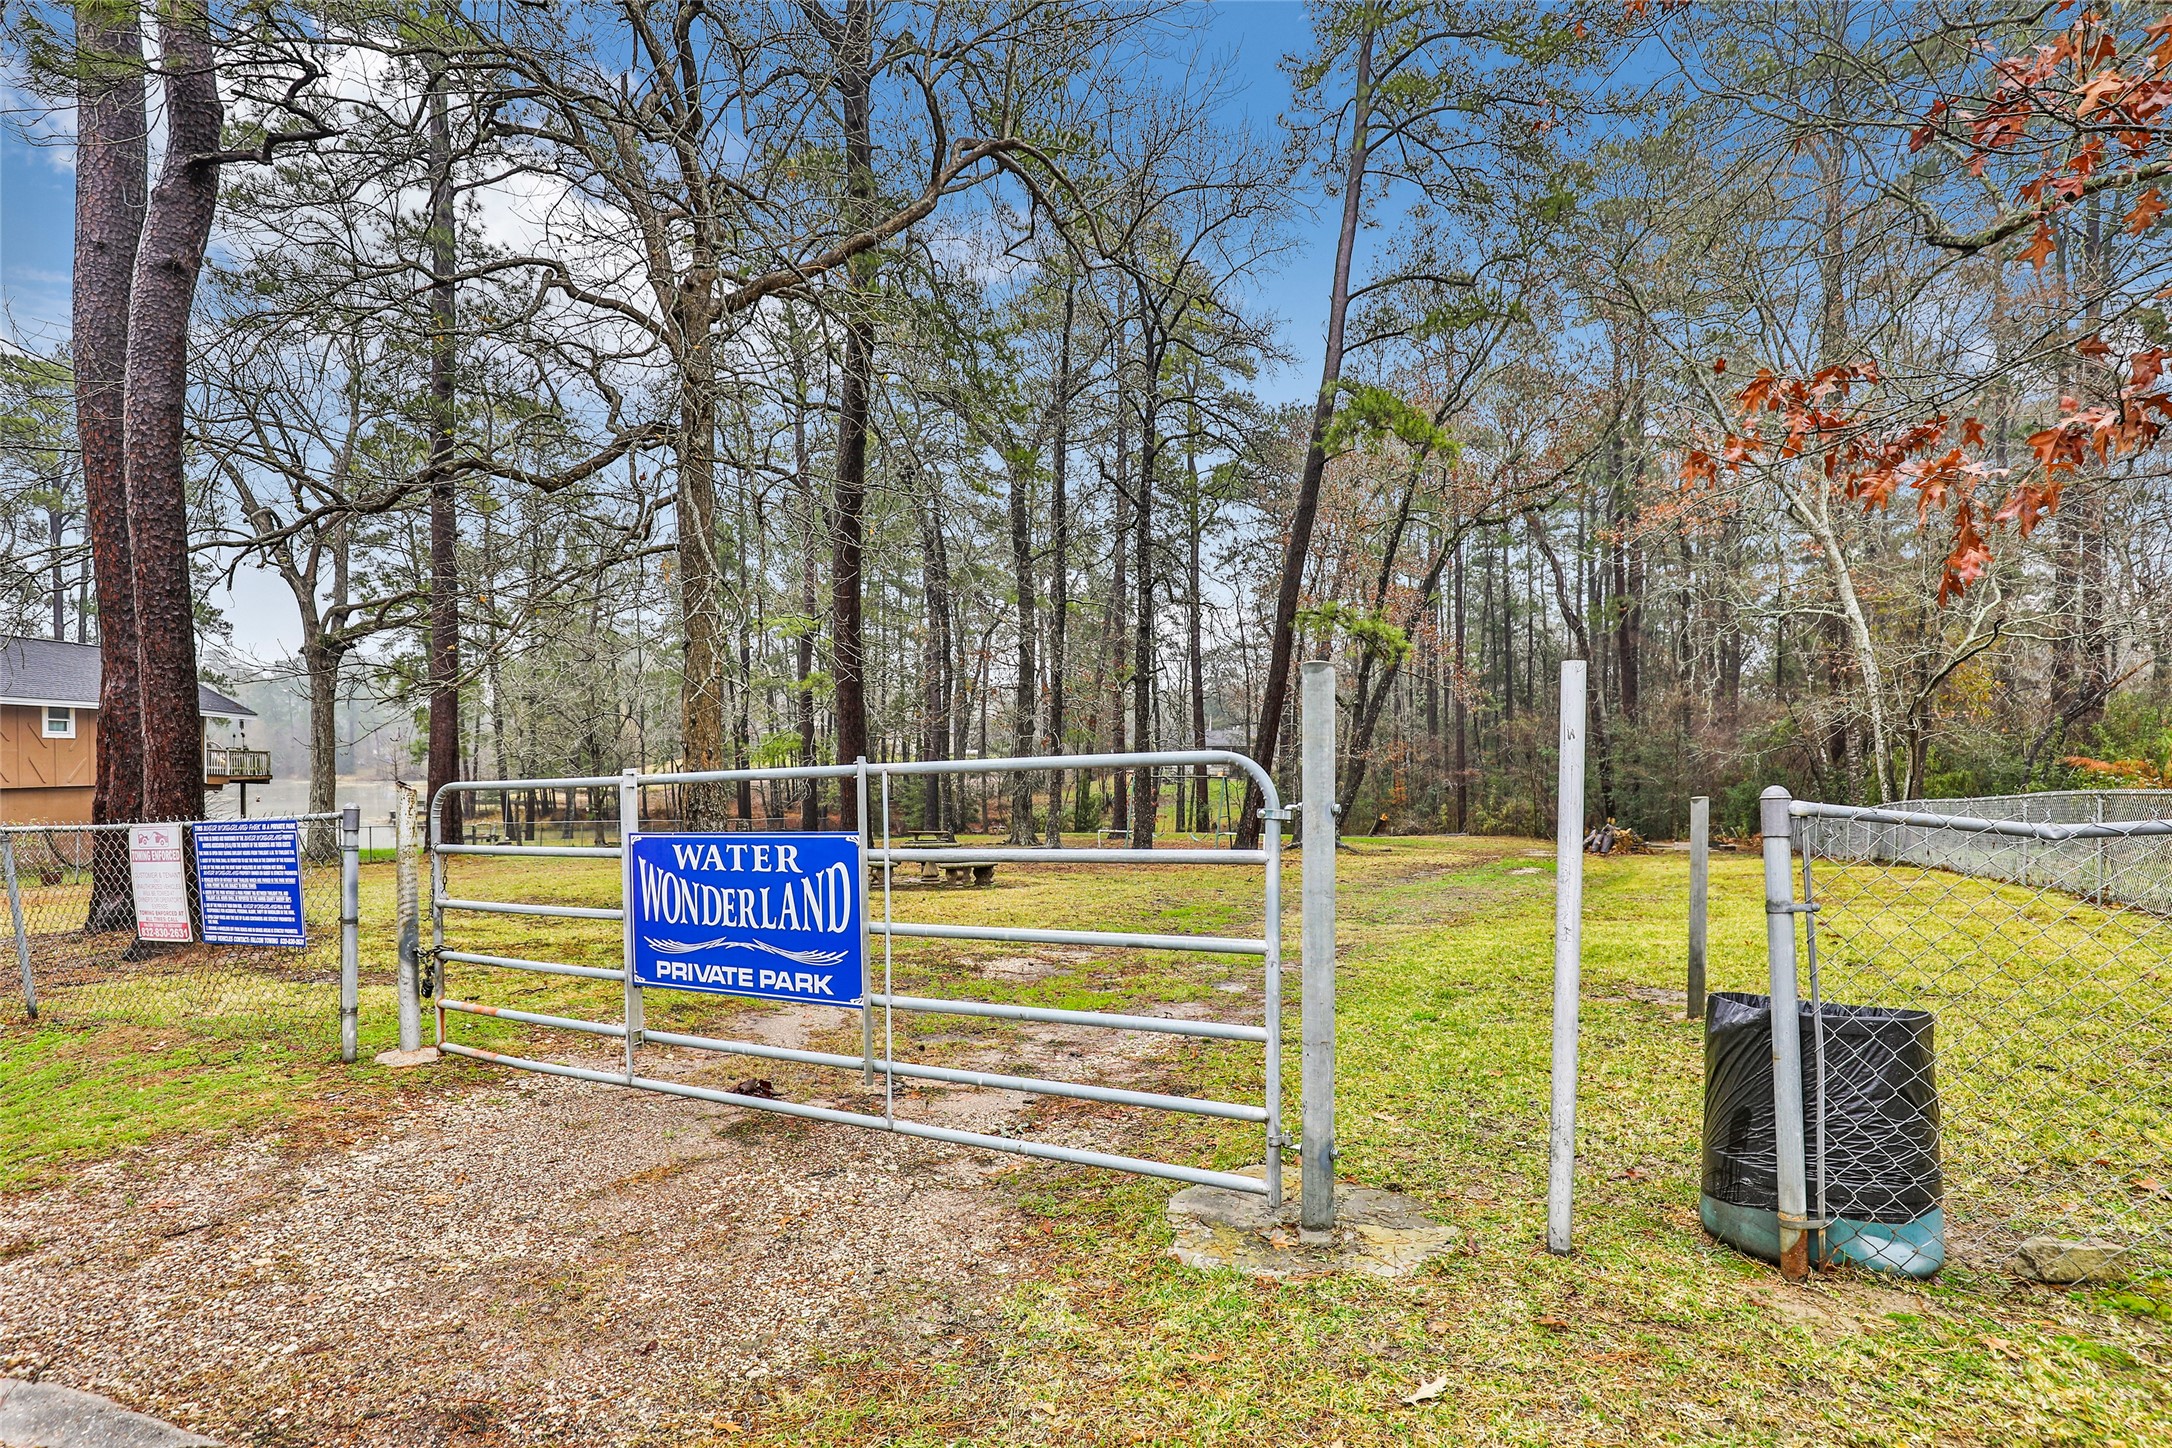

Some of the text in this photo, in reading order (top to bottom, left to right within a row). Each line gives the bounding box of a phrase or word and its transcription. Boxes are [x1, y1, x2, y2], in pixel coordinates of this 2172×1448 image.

[132, 850, 180, 861] TOWING ENFORCED
[672, 844, 803, 873] WATER
[638, 856, 851, 934] WONDERLAND
[142, 927, 188, 938] 832-830-2631
[656, 960, 835, 996] PRIVATE PARK
